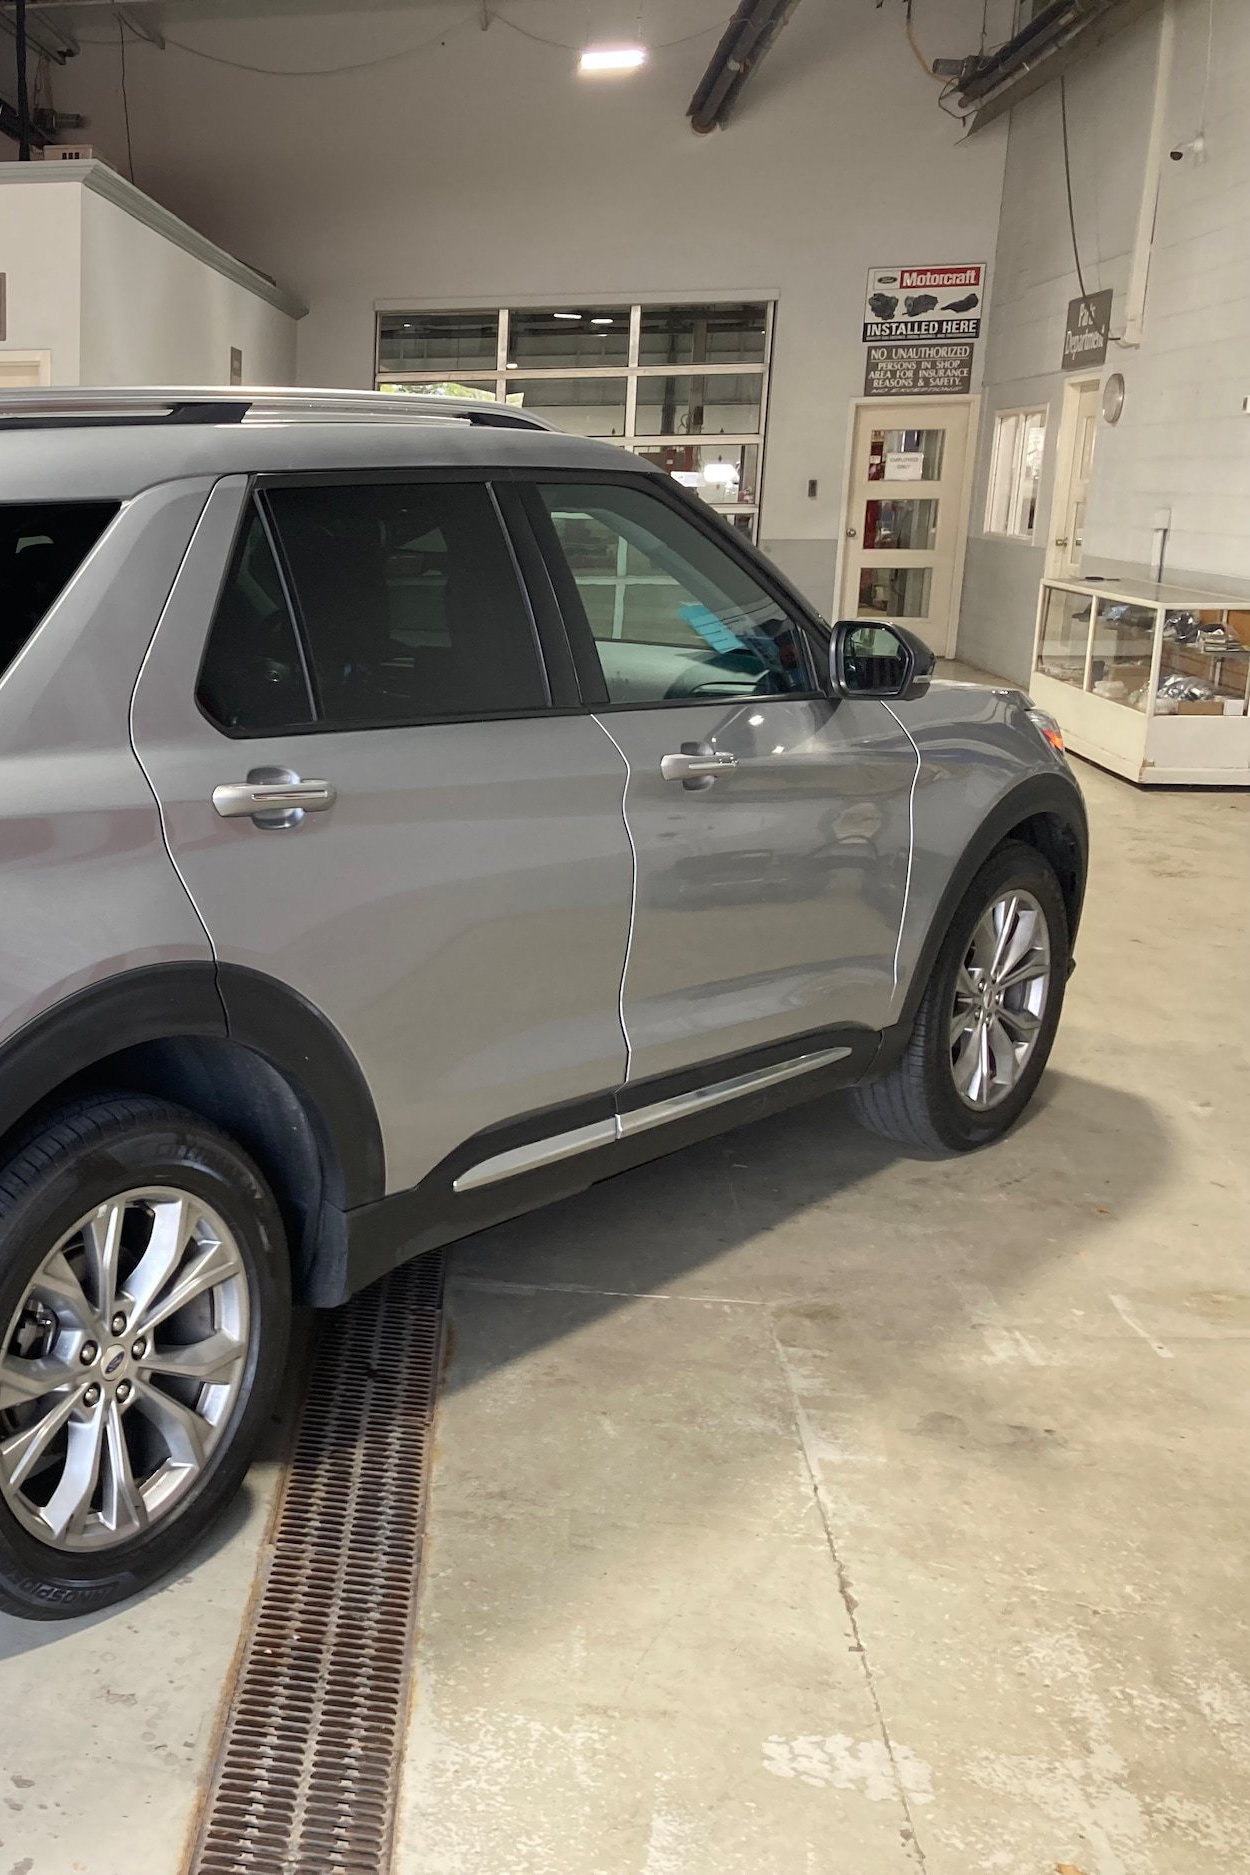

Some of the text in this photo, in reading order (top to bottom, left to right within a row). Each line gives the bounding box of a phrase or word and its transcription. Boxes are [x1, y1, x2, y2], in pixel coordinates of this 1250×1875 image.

[902, 270, 977, 287] Motorcraft
[866, 320, 978, 336] INSTALLED HERE
[870, 346, 970, 360] NO UNAUTHORIZED
[878, 360, 961, 371] PERSONS IN SHOP
[868, 368, 969, 379] AREA FOR INSURANCE
[873, 378, 913, 388] REASONS
[917, 379, 925, 387] &
